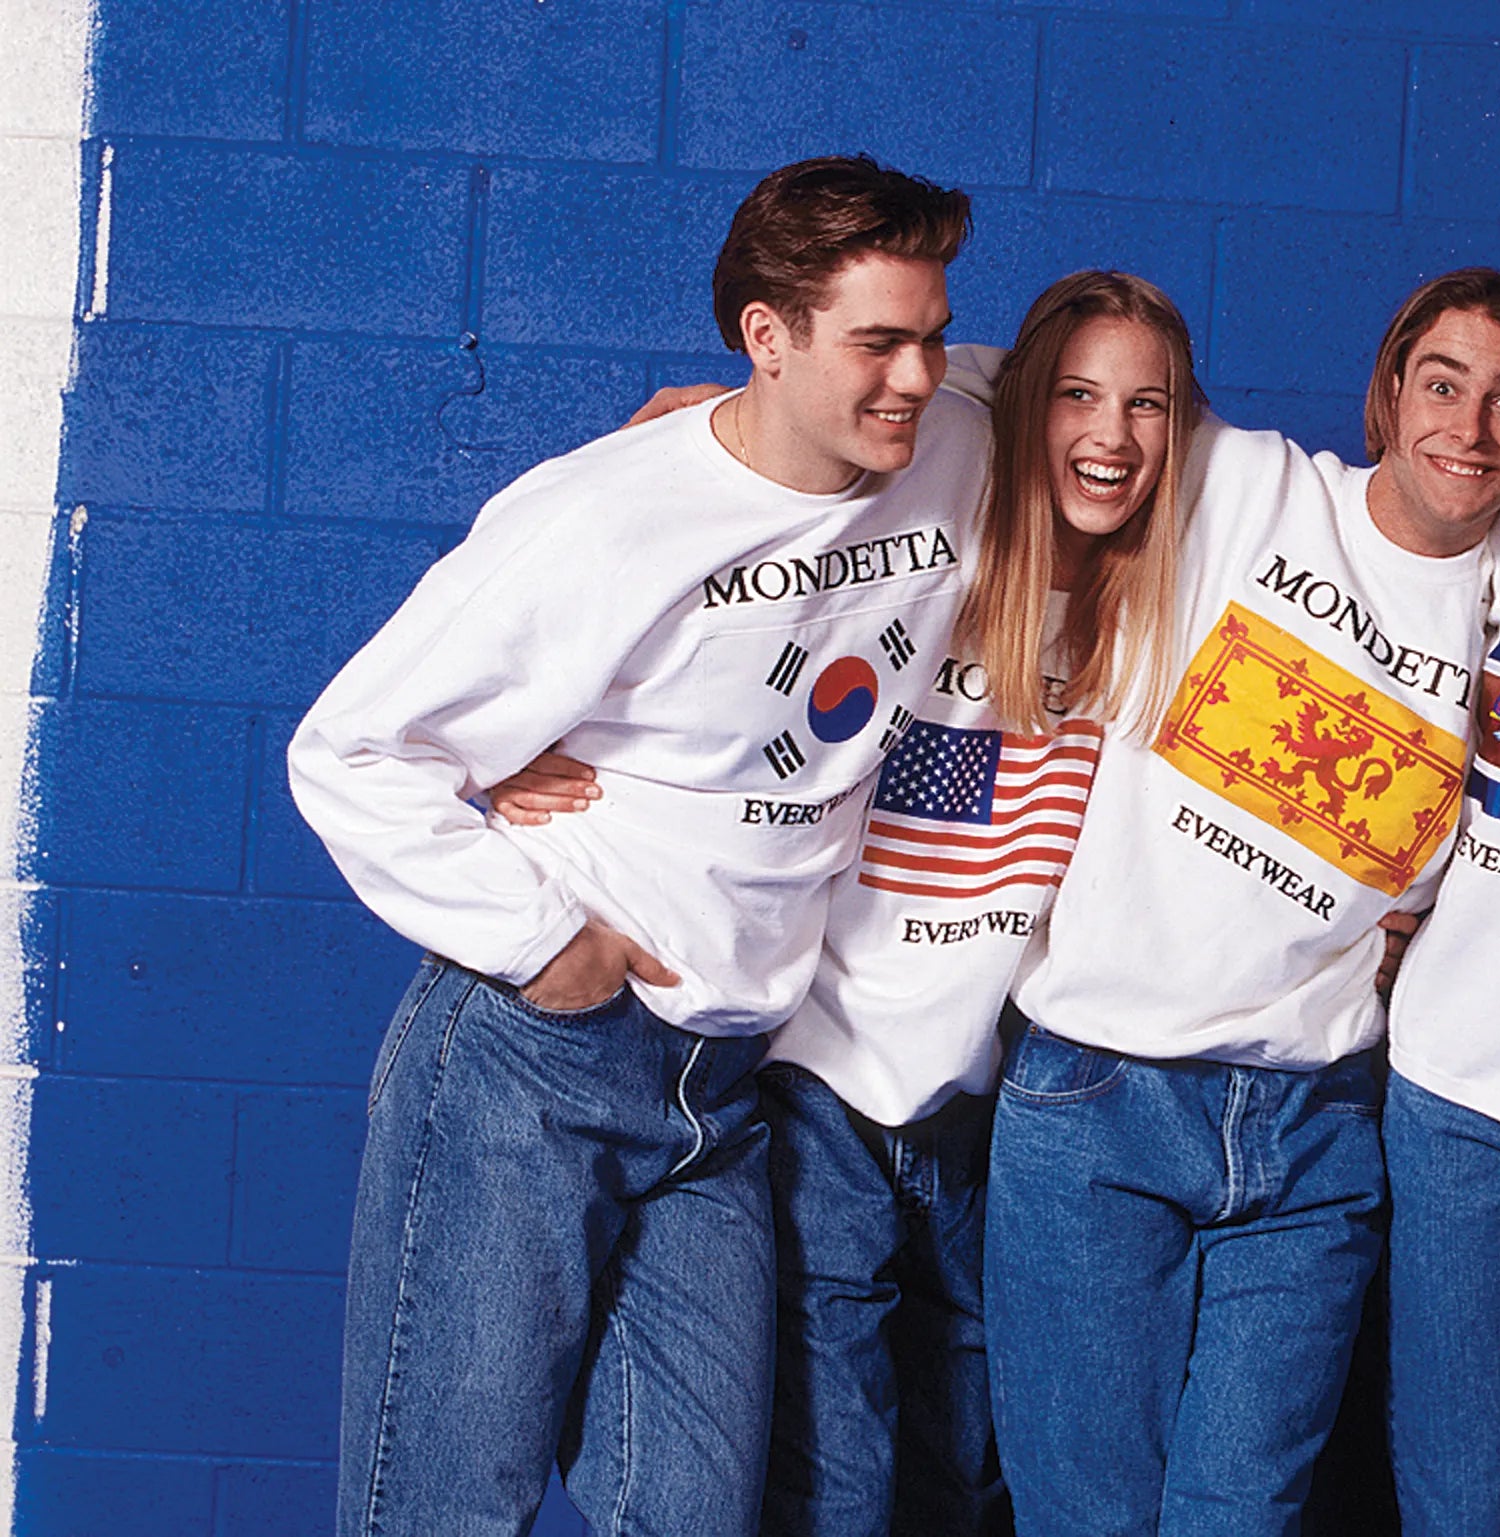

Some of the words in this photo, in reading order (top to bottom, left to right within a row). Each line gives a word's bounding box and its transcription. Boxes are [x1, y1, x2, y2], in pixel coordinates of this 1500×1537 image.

[703, 527, 958, 609] MONDETTA
[1257, 554, 1470, 711] MONDETT
[1172, 805, 1336, 921] EVERYWEAR
[901, 910, 1037, 945] EVERYWE
